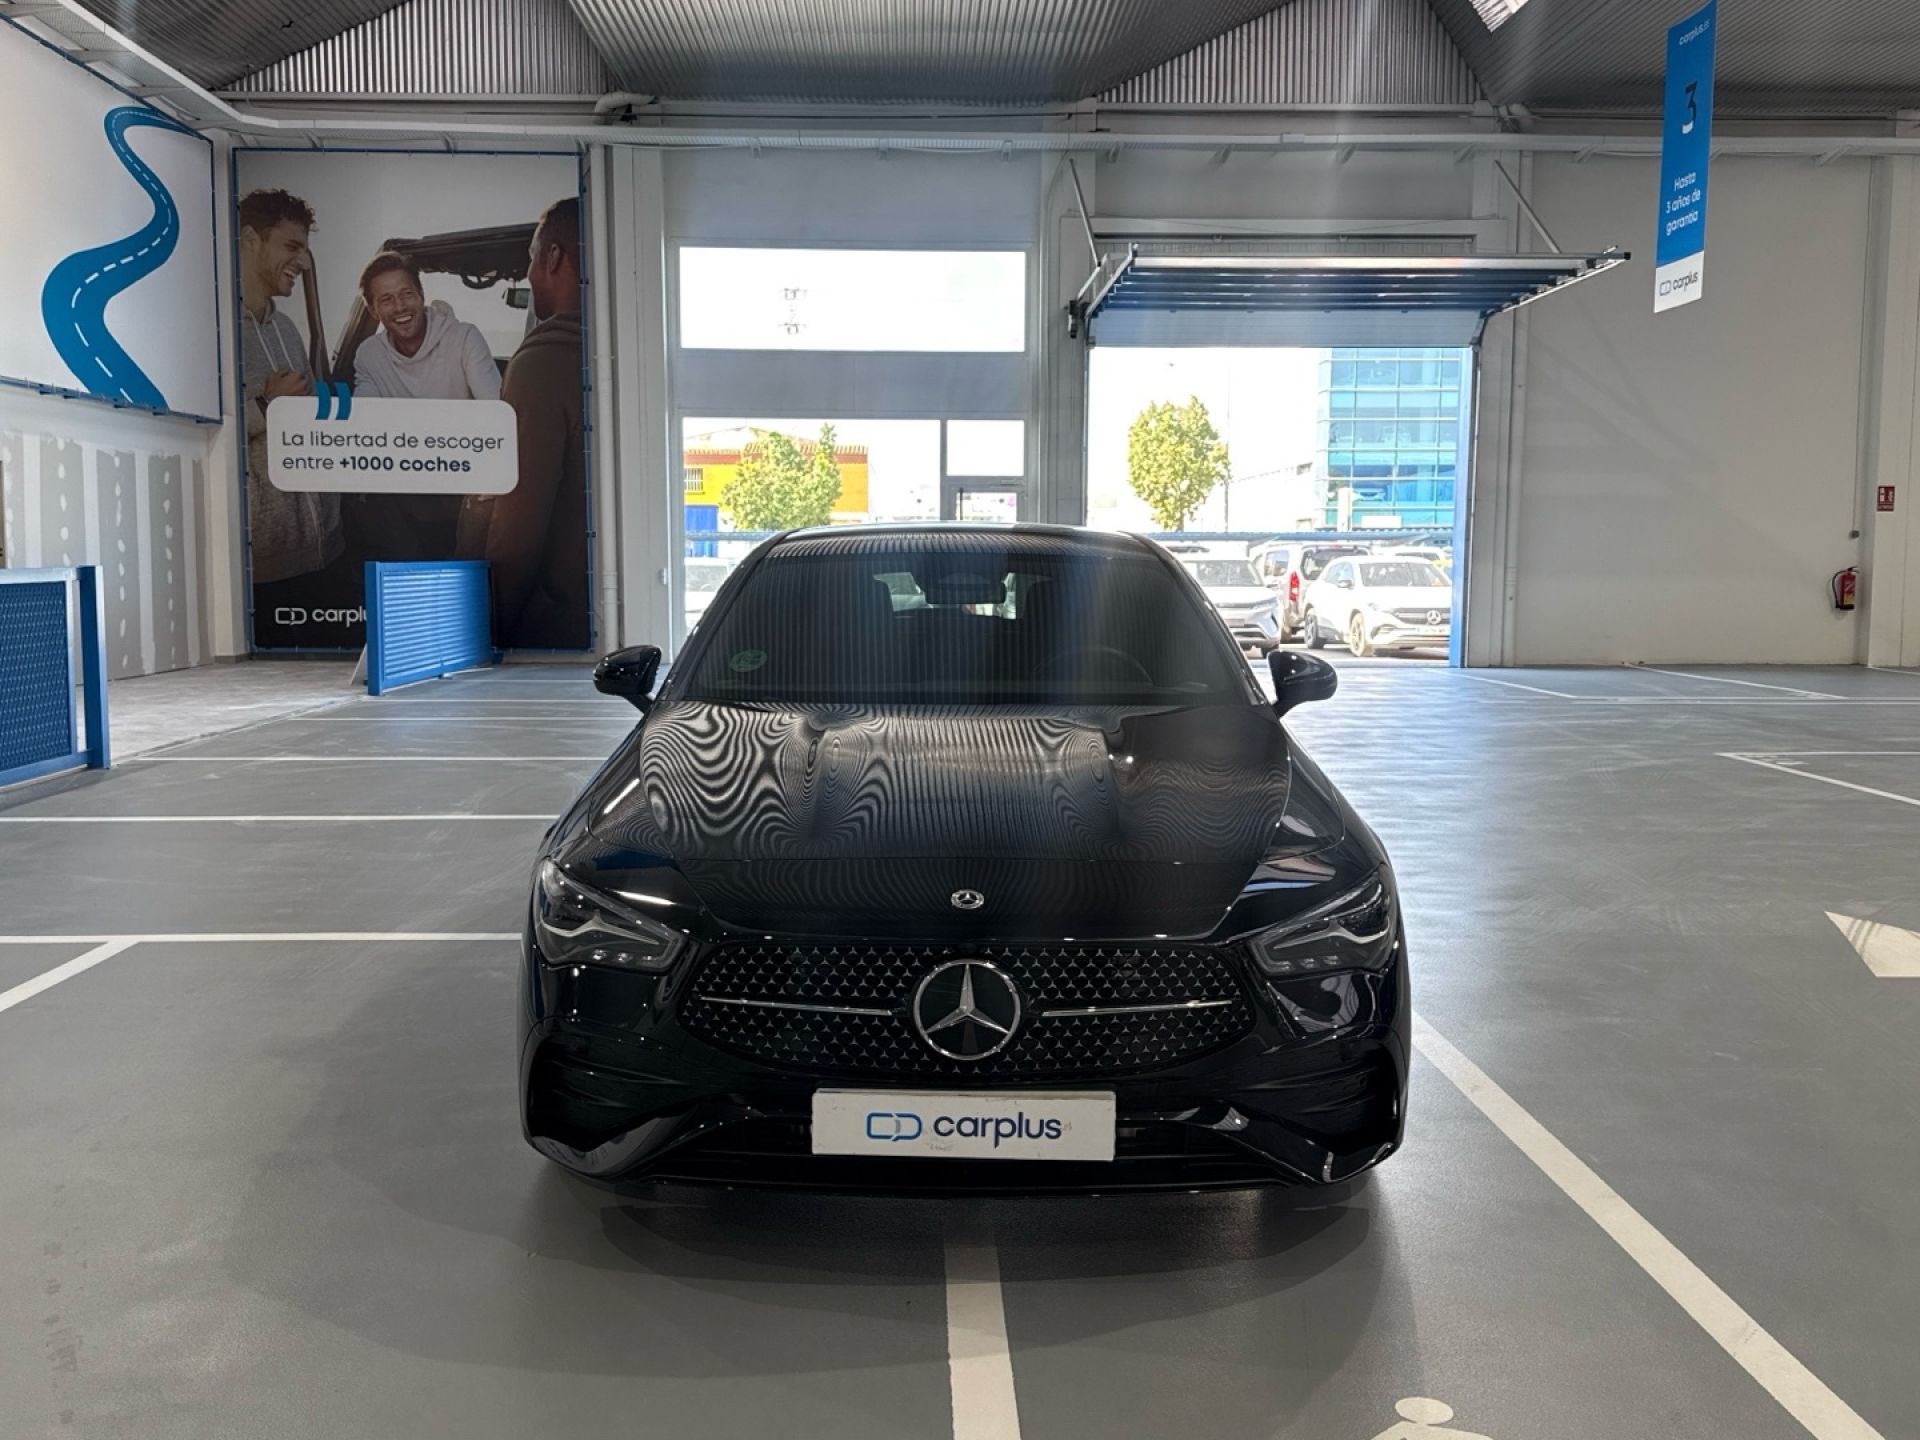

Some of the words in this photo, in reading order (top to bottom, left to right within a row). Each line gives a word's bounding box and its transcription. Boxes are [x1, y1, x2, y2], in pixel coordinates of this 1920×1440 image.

[1682, 80, 1697, 134] 3
[1674, 172, 1696, 191] Hasta
[1665, 201, 1671, 214] 3
[1671, 195, 1690, 211] años
[1691, 188, 1701, 202] de
[1673, 271, 1699, 293] carplus
[282, 431, 304, 447] La
[310, 431, 388, 448] libertad
[392, 433, 419, 449] de
[424, 436, 505, 452] escoger
[282, 457, 334, 470] entre
[339, 456, 394, 470] +1000
[399, 457, 471, 472] coches
[933, 1112, 1062, 1149] carplus
